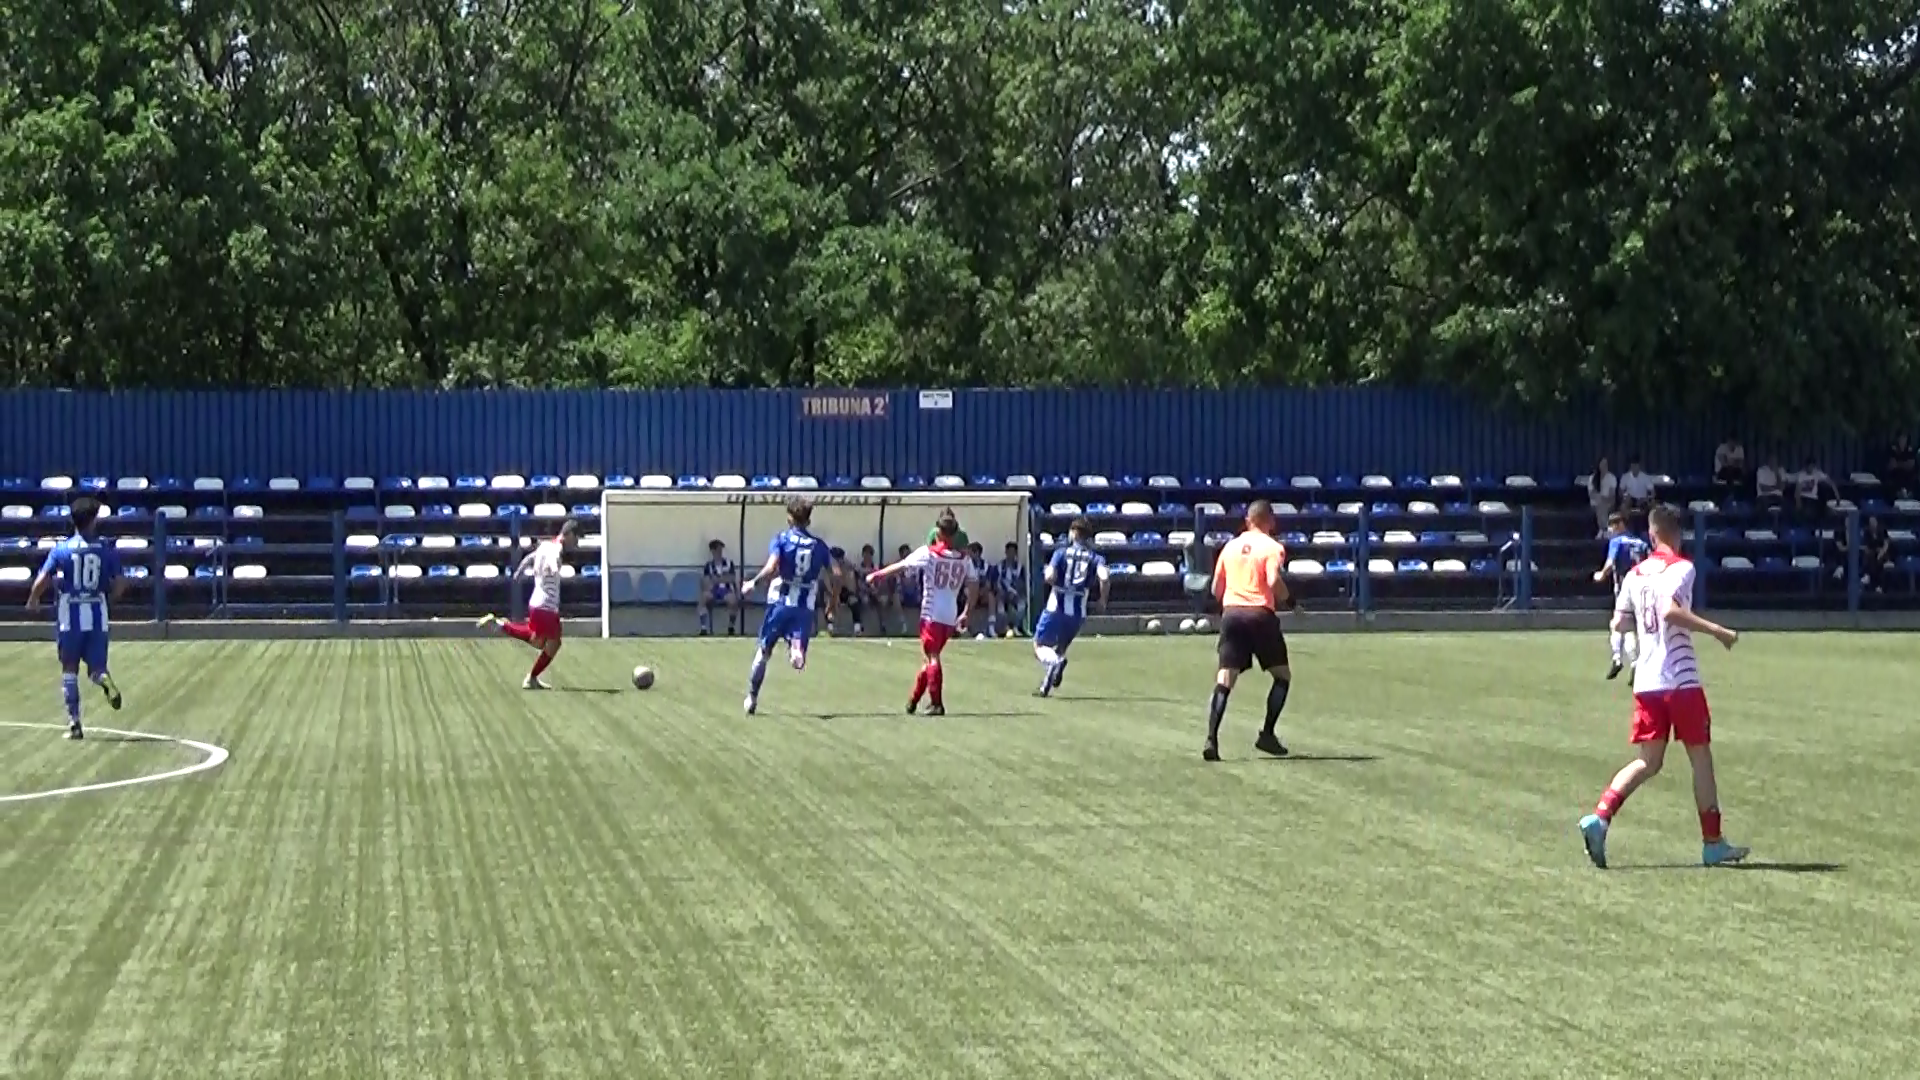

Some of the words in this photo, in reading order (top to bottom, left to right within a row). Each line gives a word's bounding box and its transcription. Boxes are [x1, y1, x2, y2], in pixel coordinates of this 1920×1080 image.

[801, 397, 871, 416] TRIBUNA
[71, 553, 101, 590] 18
[934, 561, 965, 590] 69
